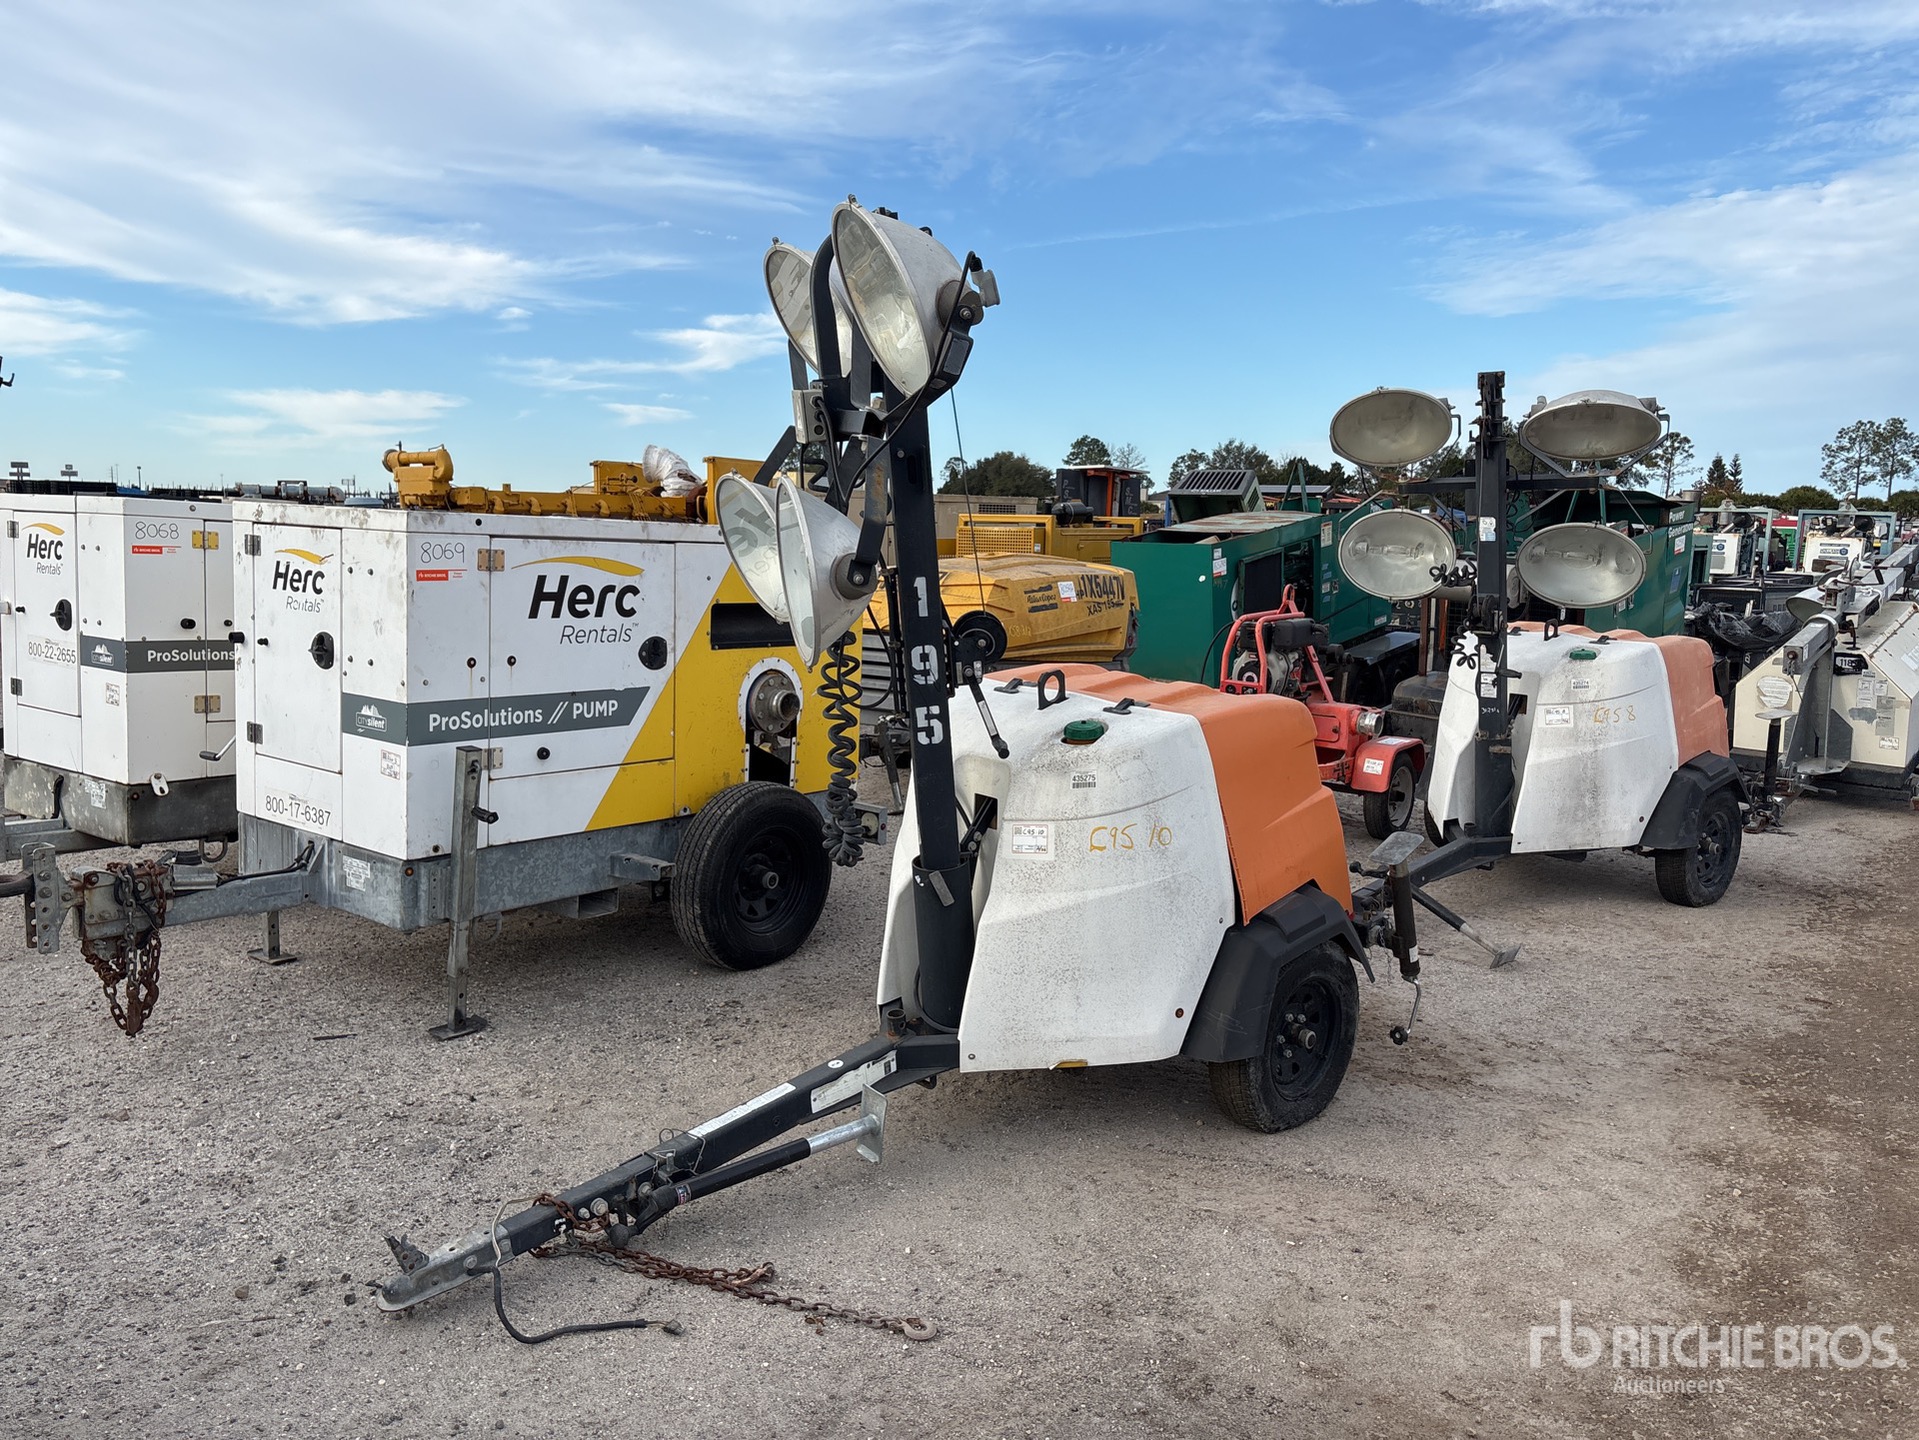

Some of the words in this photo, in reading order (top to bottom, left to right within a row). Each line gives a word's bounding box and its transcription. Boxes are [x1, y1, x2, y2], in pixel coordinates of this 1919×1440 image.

[1669, 510, 1685, 523] Power
[135, 521, 180, 540] 8068
[1668, 522, 1694, 539] Generation
[26, 533, 64, 560] Herc
[420, 541, 465, 563] 8069
[272, 560, 325, 595] Herc
[528, 574, 641, 619] Herc
[28, 641, 77, 664] 800-22-2655
[147, 648, 236, 663] ProSolutions
[428, 707, 543, 732] ProSolutions
[572, 699, 619, 719] PUMP
[1072, 774, 1096, 782] 435275
[265, 795, 331, 827] 800-17-6387
